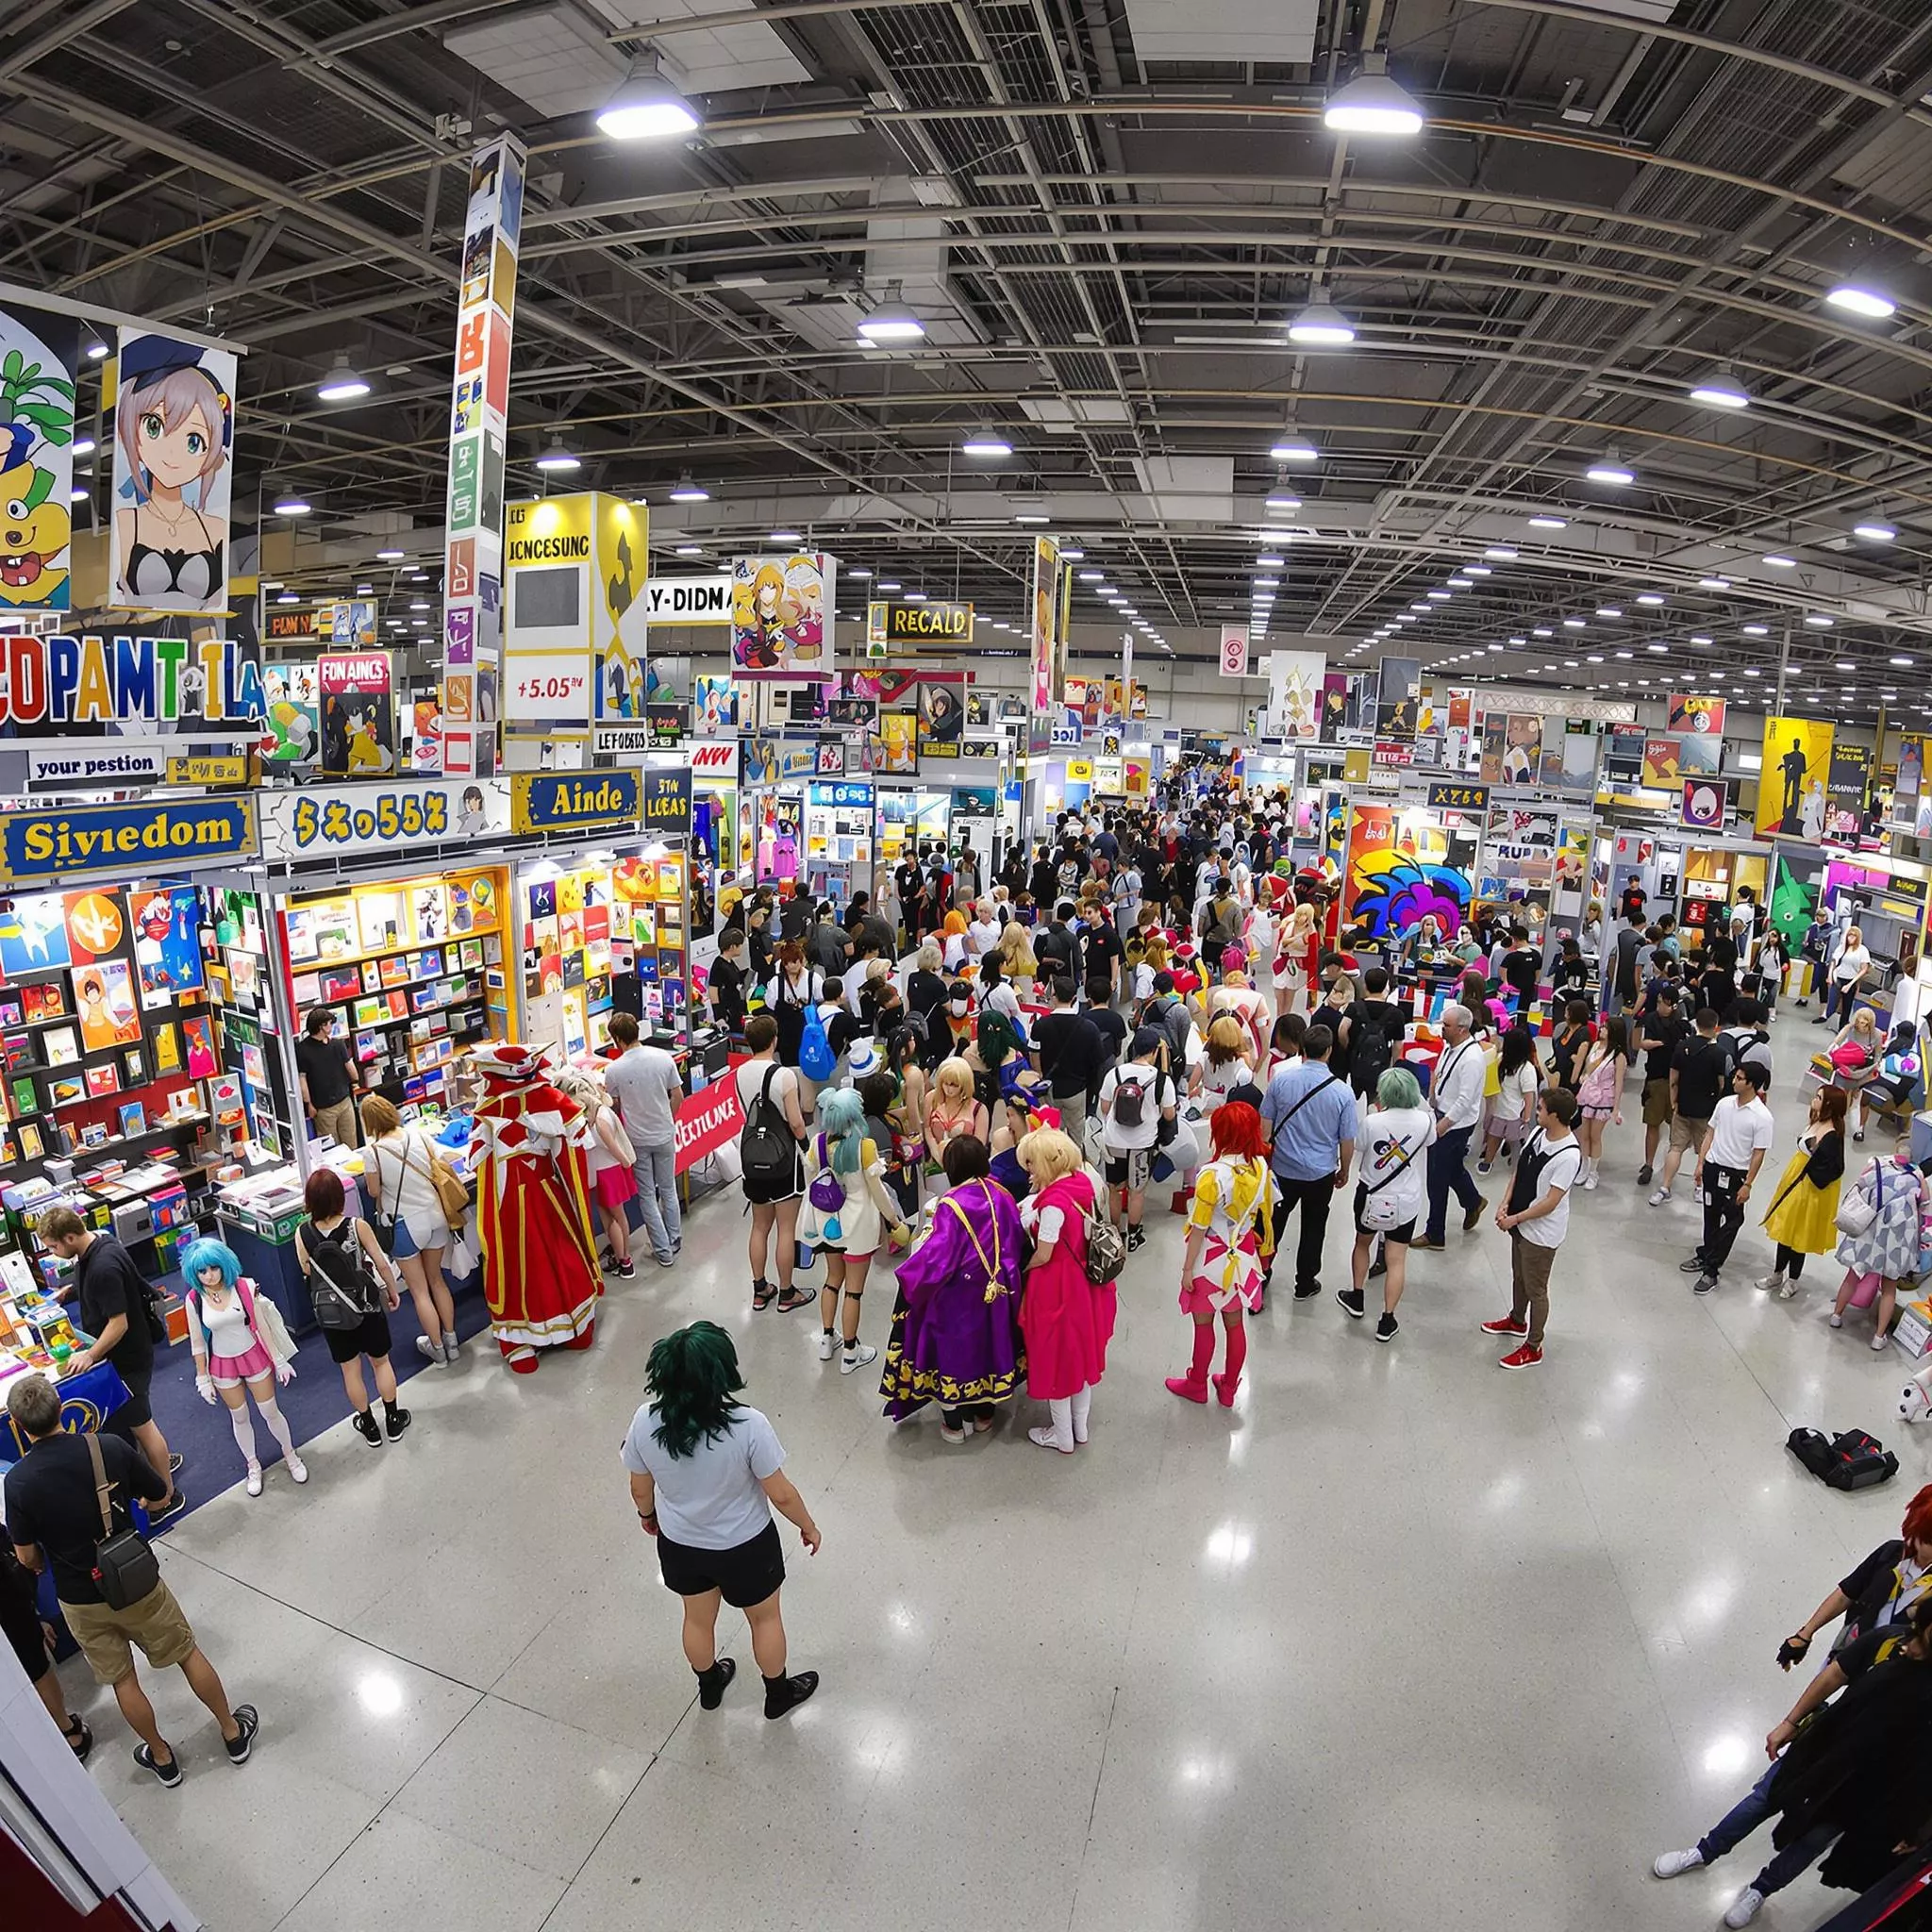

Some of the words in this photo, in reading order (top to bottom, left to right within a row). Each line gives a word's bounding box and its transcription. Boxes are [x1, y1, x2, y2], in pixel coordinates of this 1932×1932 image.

[646, 587, 732, 612] Y-DIDM
[37, 760, 81, 779] your
[85, 755, 154, 775] pestion
[551, 779, 623, 815] Ainde
